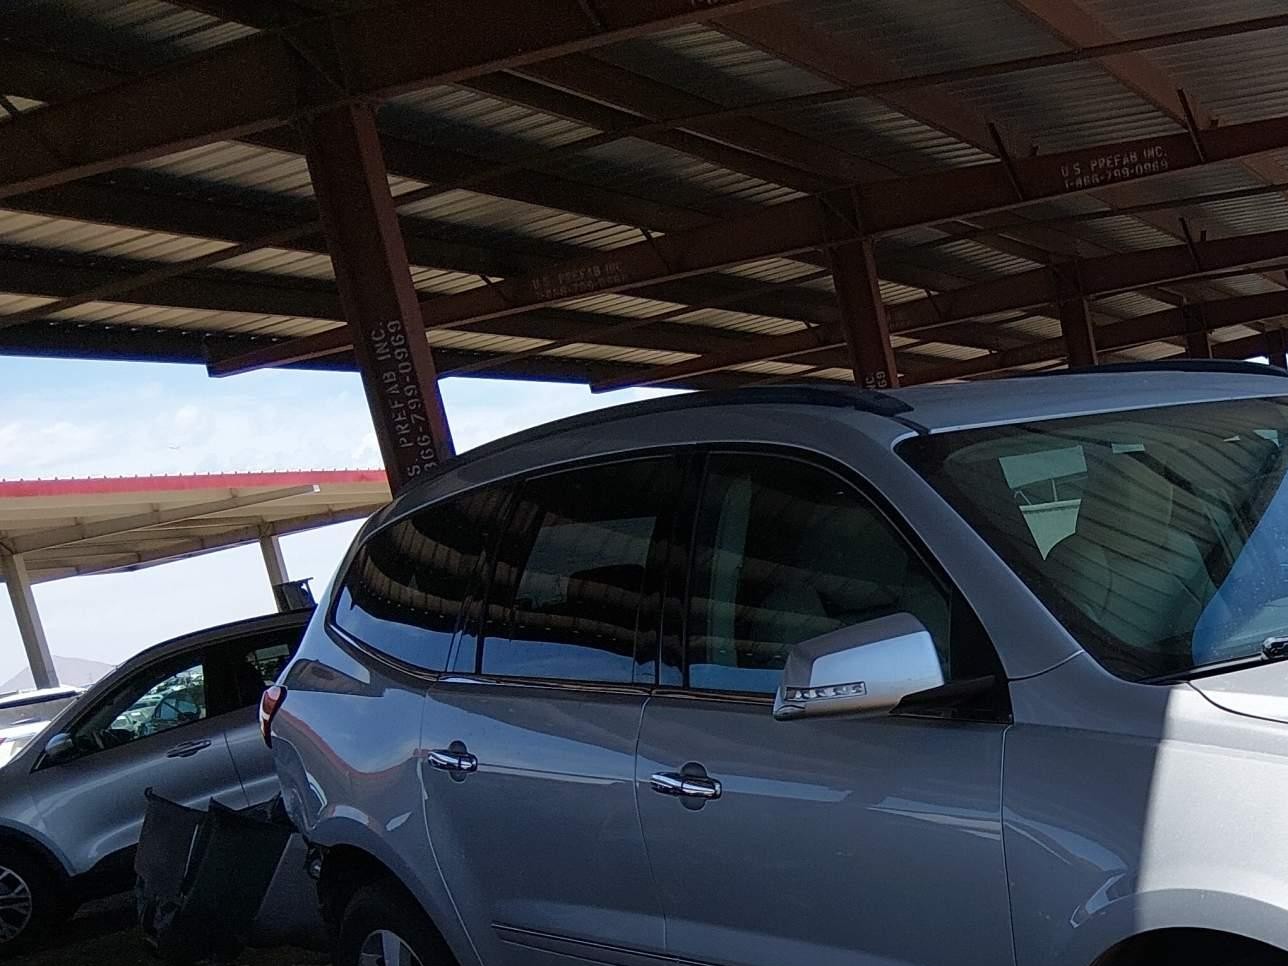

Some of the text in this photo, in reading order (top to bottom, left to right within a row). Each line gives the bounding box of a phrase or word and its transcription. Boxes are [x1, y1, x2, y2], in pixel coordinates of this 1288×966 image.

[1090, 151, 1138, 172] PREFAB
[370, 322, 392, 361] INC.
[383, 371, 415, 448] PREFAB
